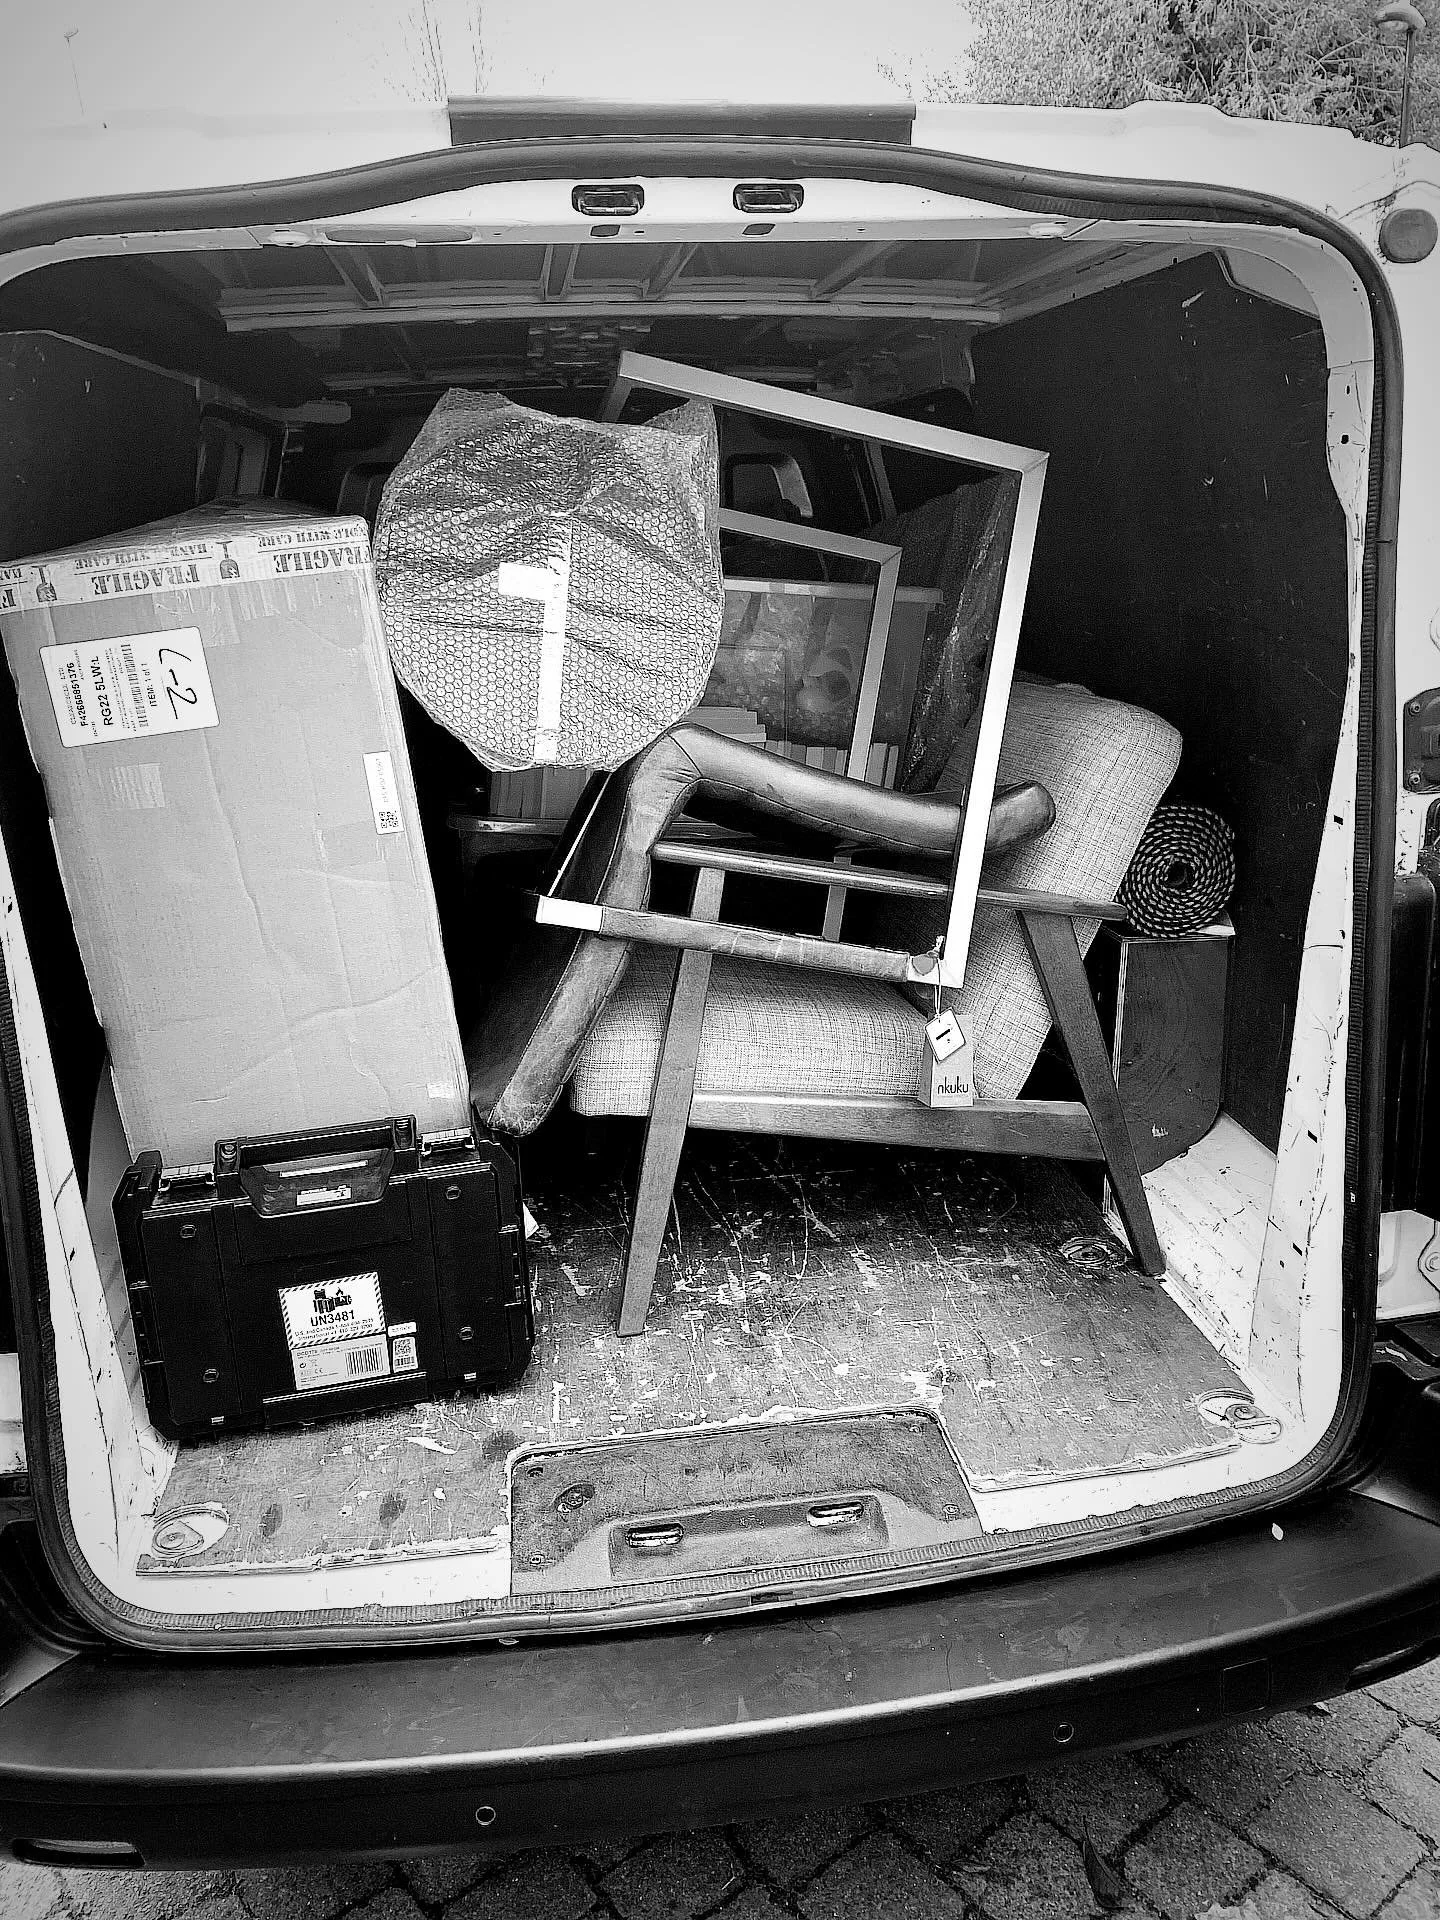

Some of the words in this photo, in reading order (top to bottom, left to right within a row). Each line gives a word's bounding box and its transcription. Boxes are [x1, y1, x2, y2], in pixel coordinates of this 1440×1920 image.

[273, 545, 373, 573] FRAGILE
[91, 563, 201, 595] FRAGILE
[146, 684, 158, 708] ITEM:
[97, 694, 114, 726] RG22
[937, 1075, 969, 1095] nkuku
[310, 1309, 355, 1327] UN3481
